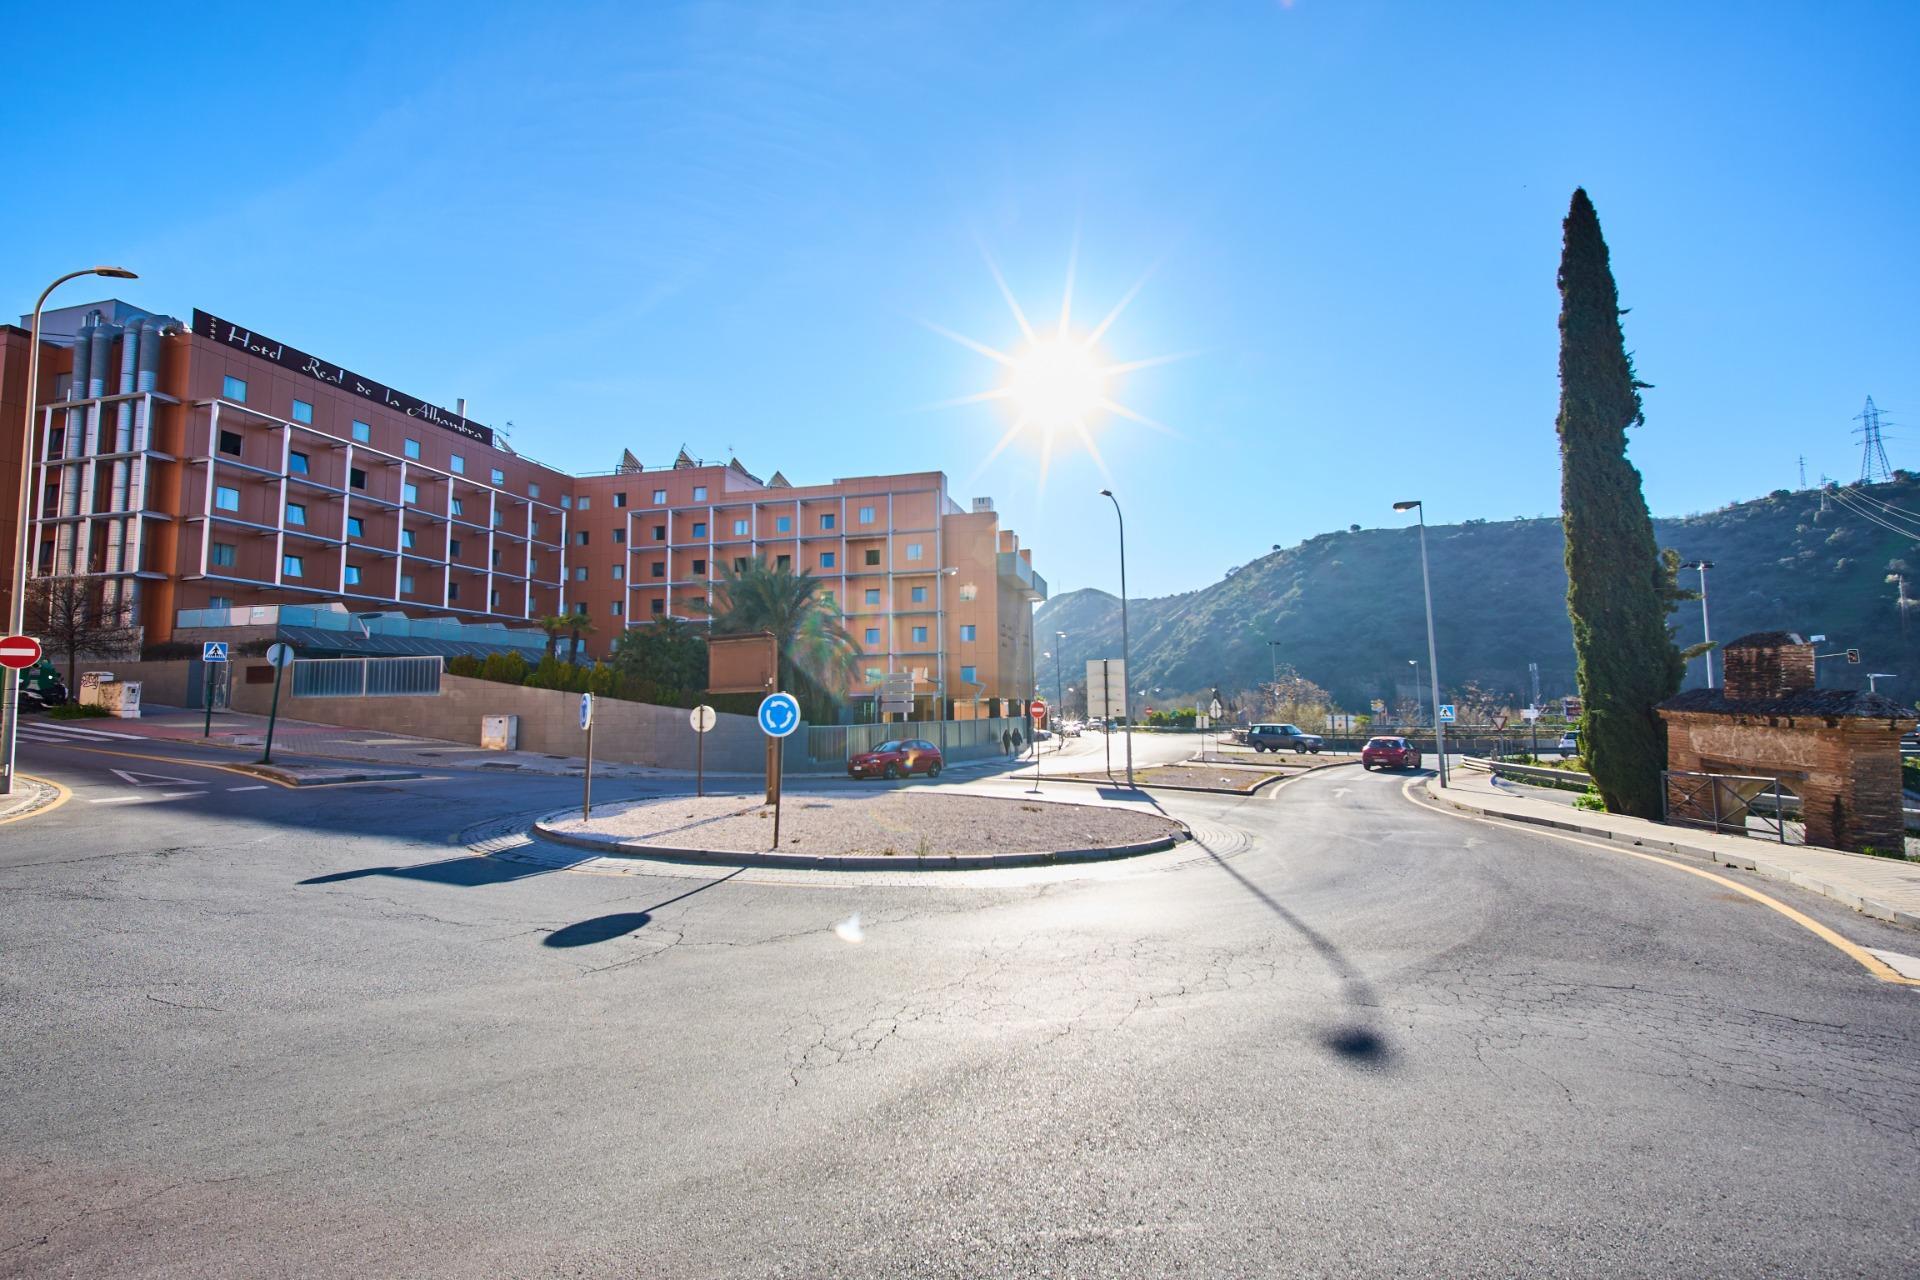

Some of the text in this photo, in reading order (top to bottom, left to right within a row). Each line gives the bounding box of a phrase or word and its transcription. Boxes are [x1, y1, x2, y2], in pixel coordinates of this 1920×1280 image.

[228, 326, 482, 439] Hotel Real de la Alhambra
